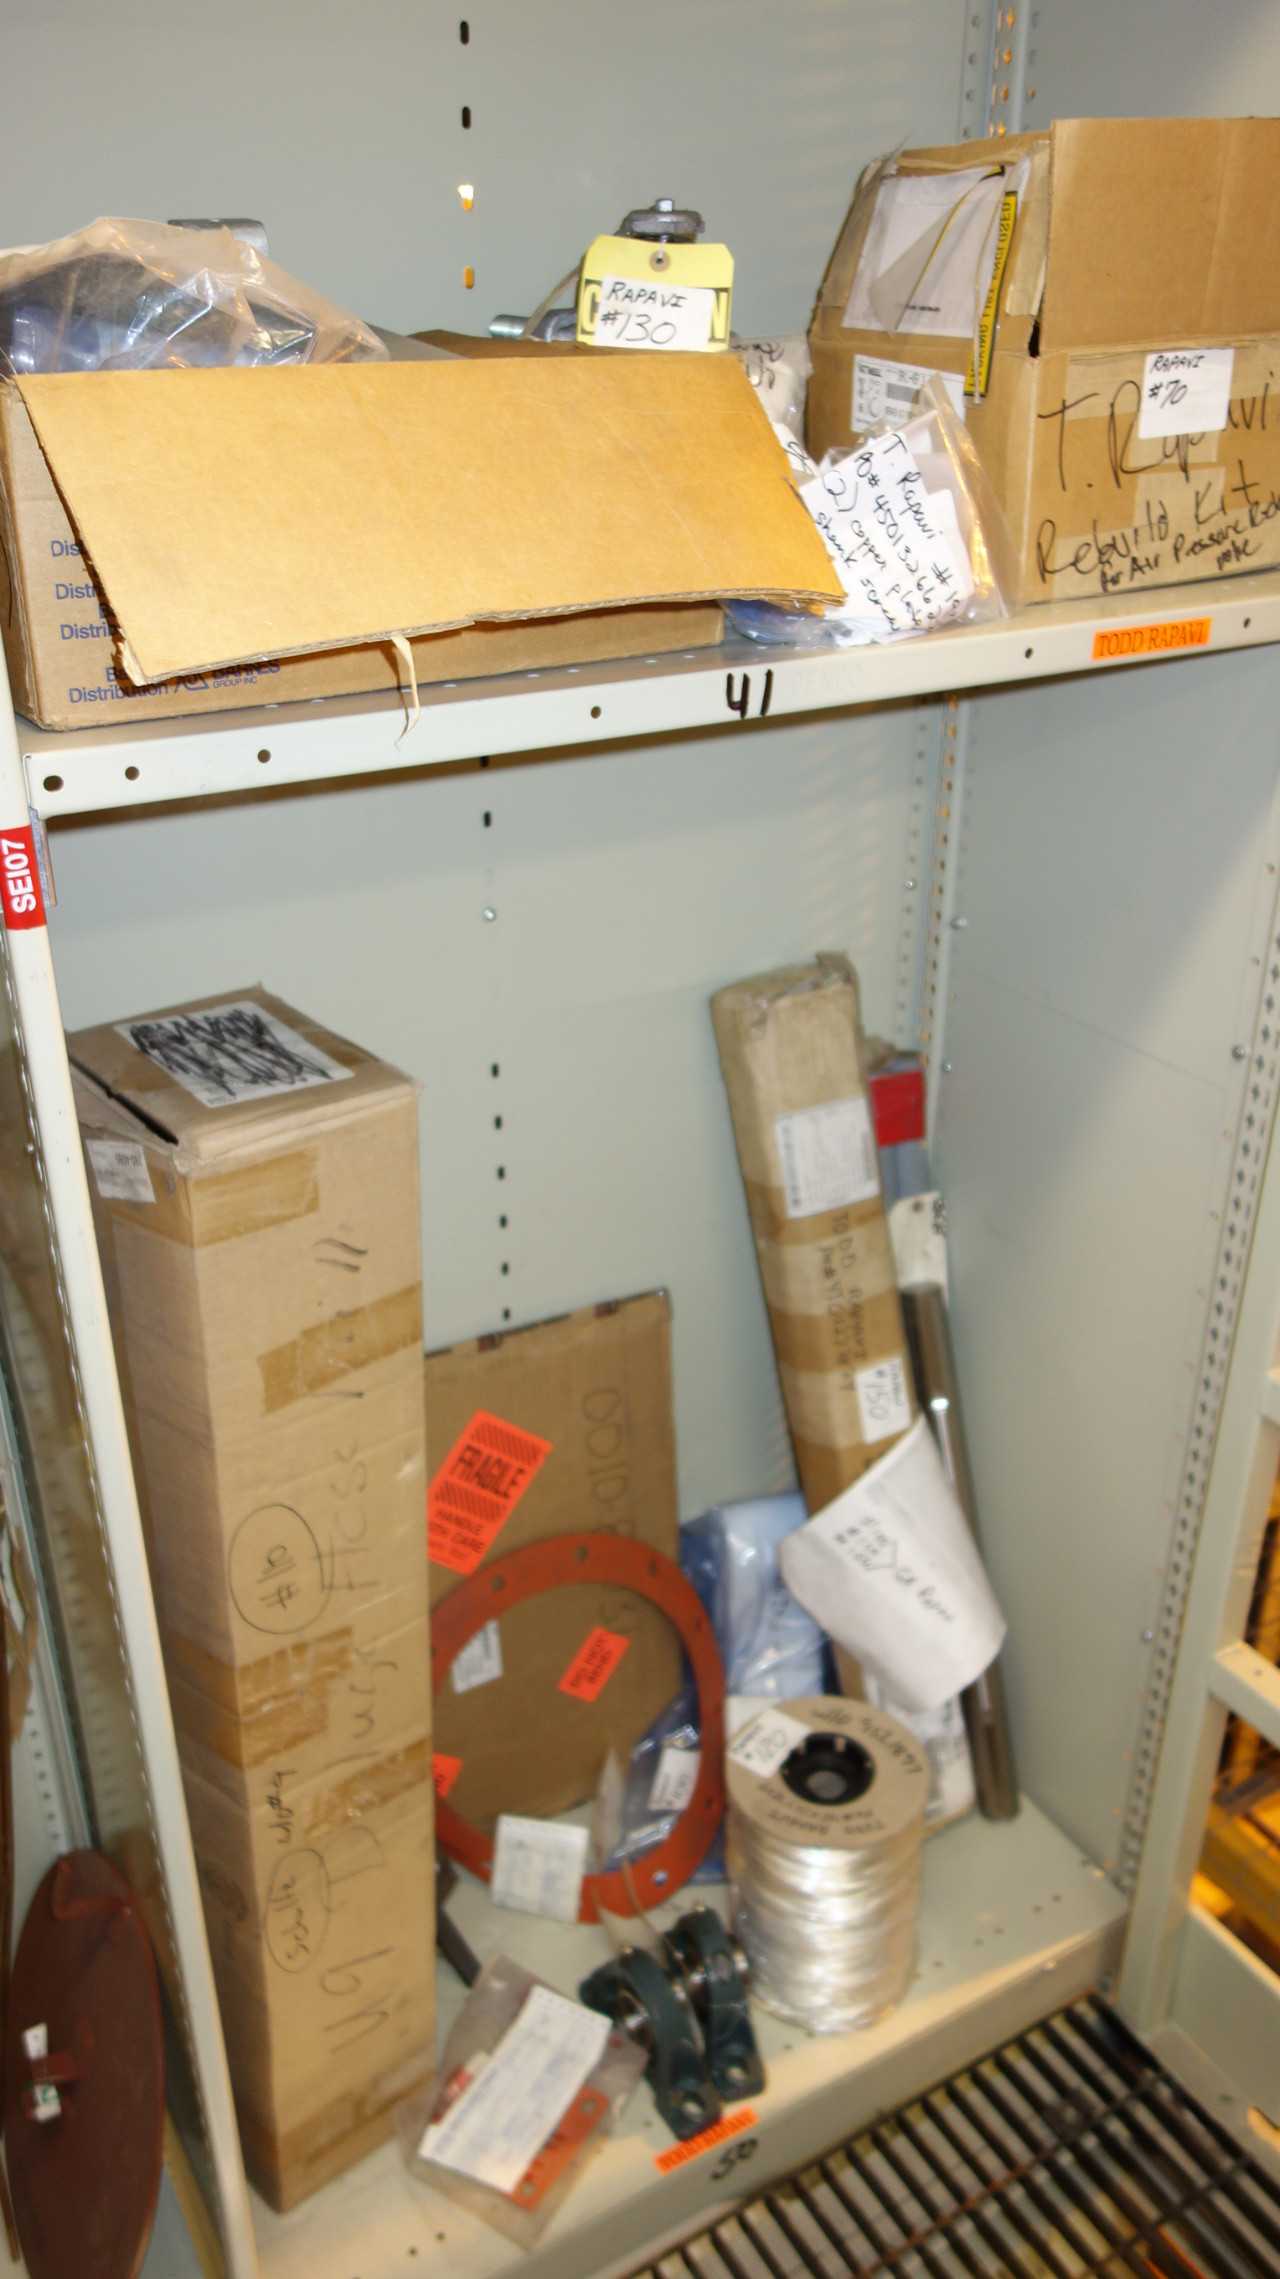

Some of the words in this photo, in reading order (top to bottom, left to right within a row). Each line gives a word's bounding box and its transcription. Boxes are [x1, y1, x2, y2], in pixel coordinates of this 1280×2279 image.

[607, 281, 688, 308] RAPAVI
[601, 309, 677, 345] #130
[1148, 380, 1188, 409] #70
[1097, 630, 1144, 657] TODD
[1146, 622, 1205, 652] RAPAVI
[726, 669, 774, 719] 41
